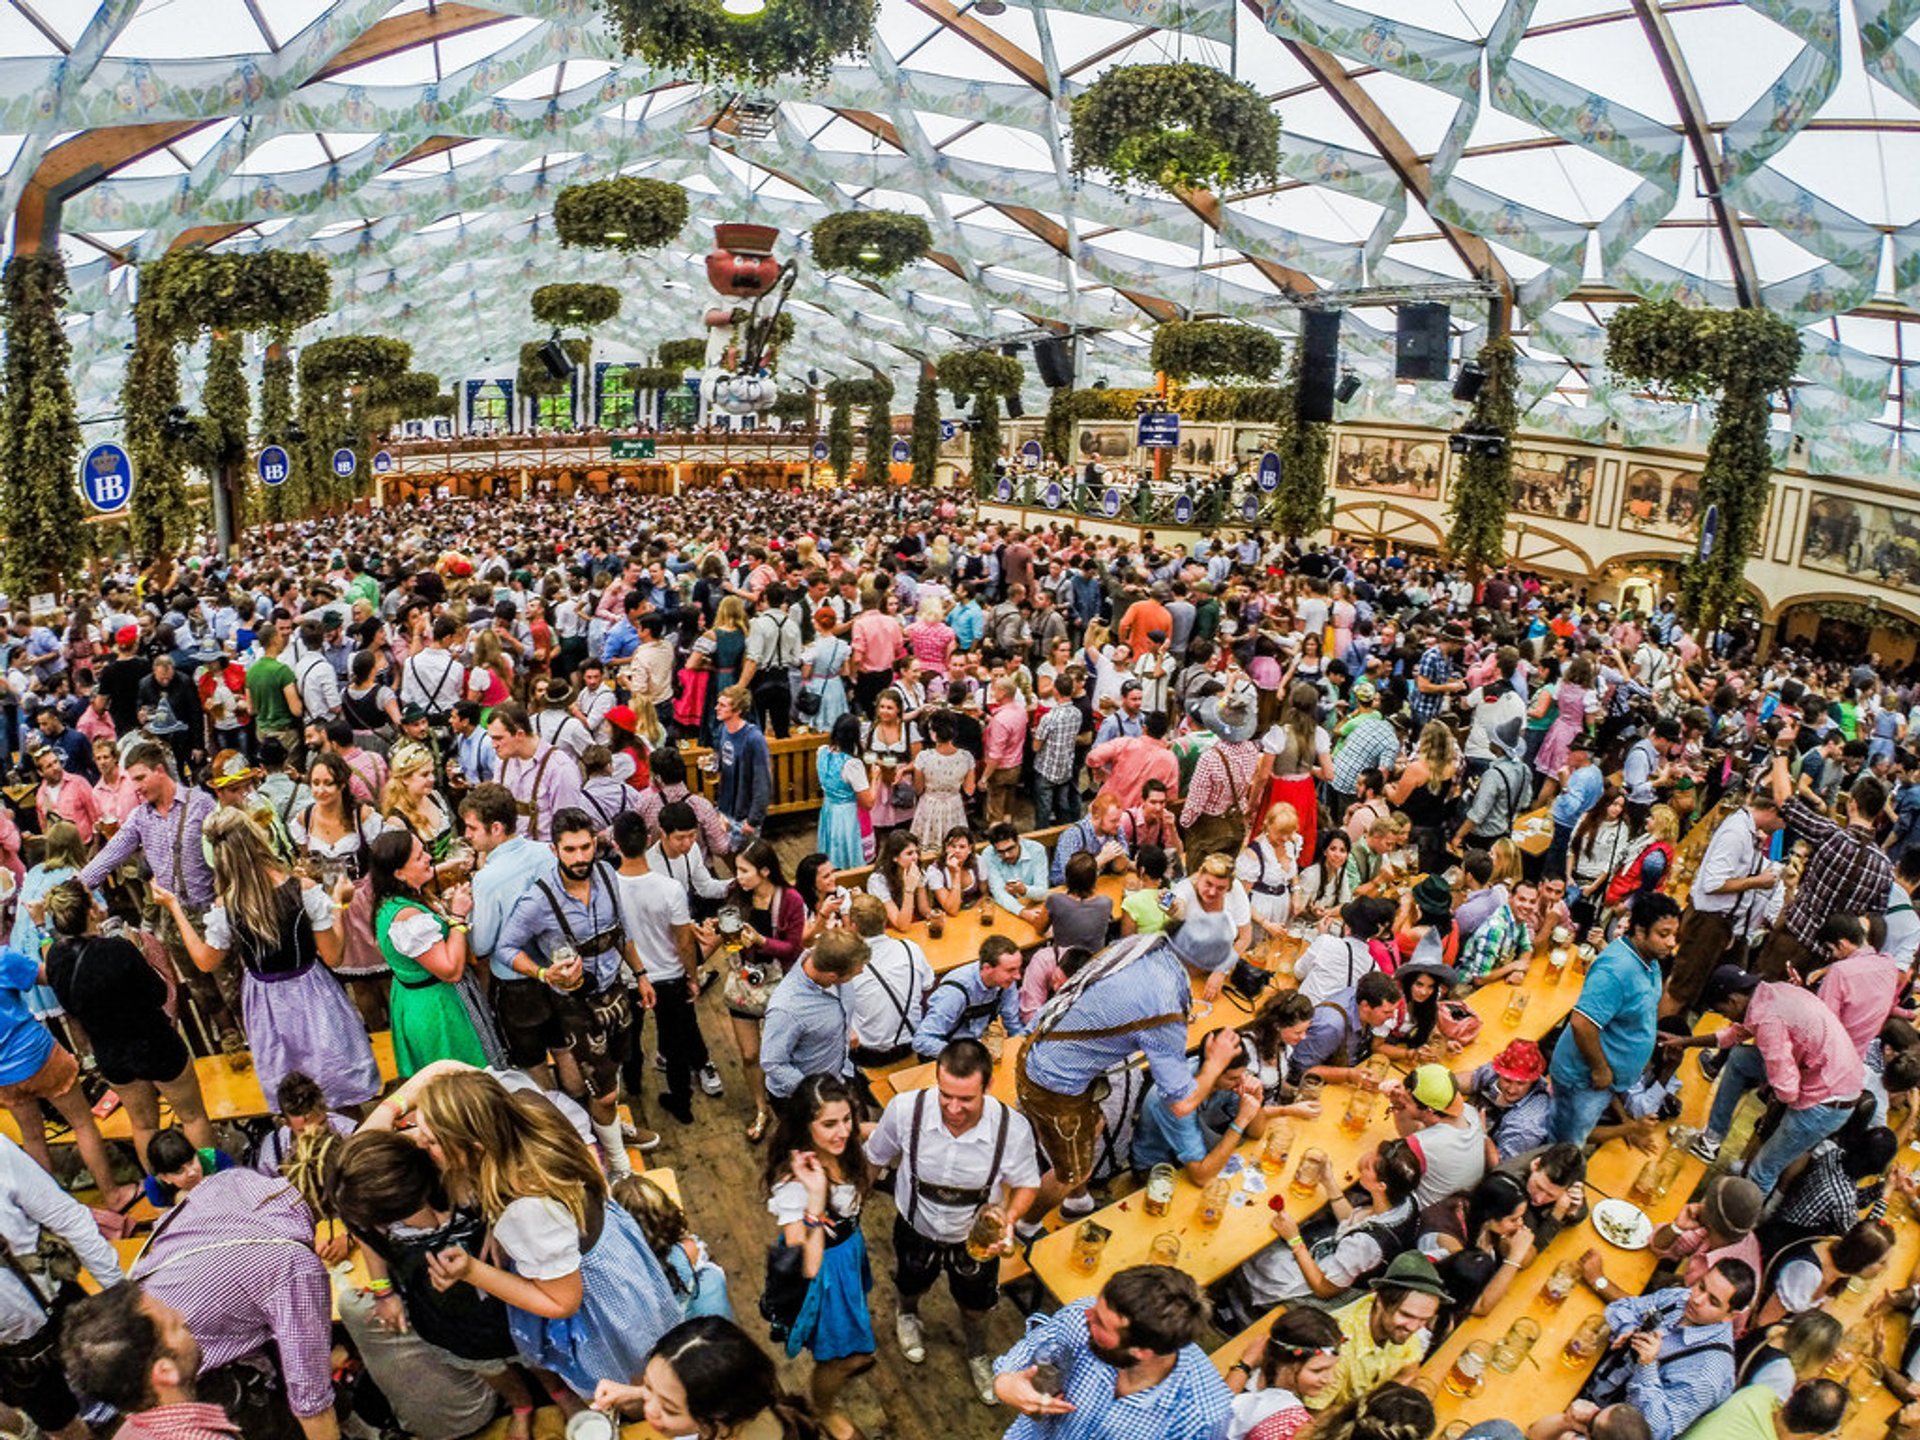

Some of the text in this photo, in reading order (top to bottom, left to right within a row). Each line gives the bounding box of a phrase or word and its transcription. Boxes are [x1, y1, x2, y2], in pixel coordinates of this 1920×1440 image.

[265, 464, 284, 480] HB
[338, 461, 352, 472] HB
[1262, 470, 1278, 486] HB
[94, 475, 123, 502] HB
